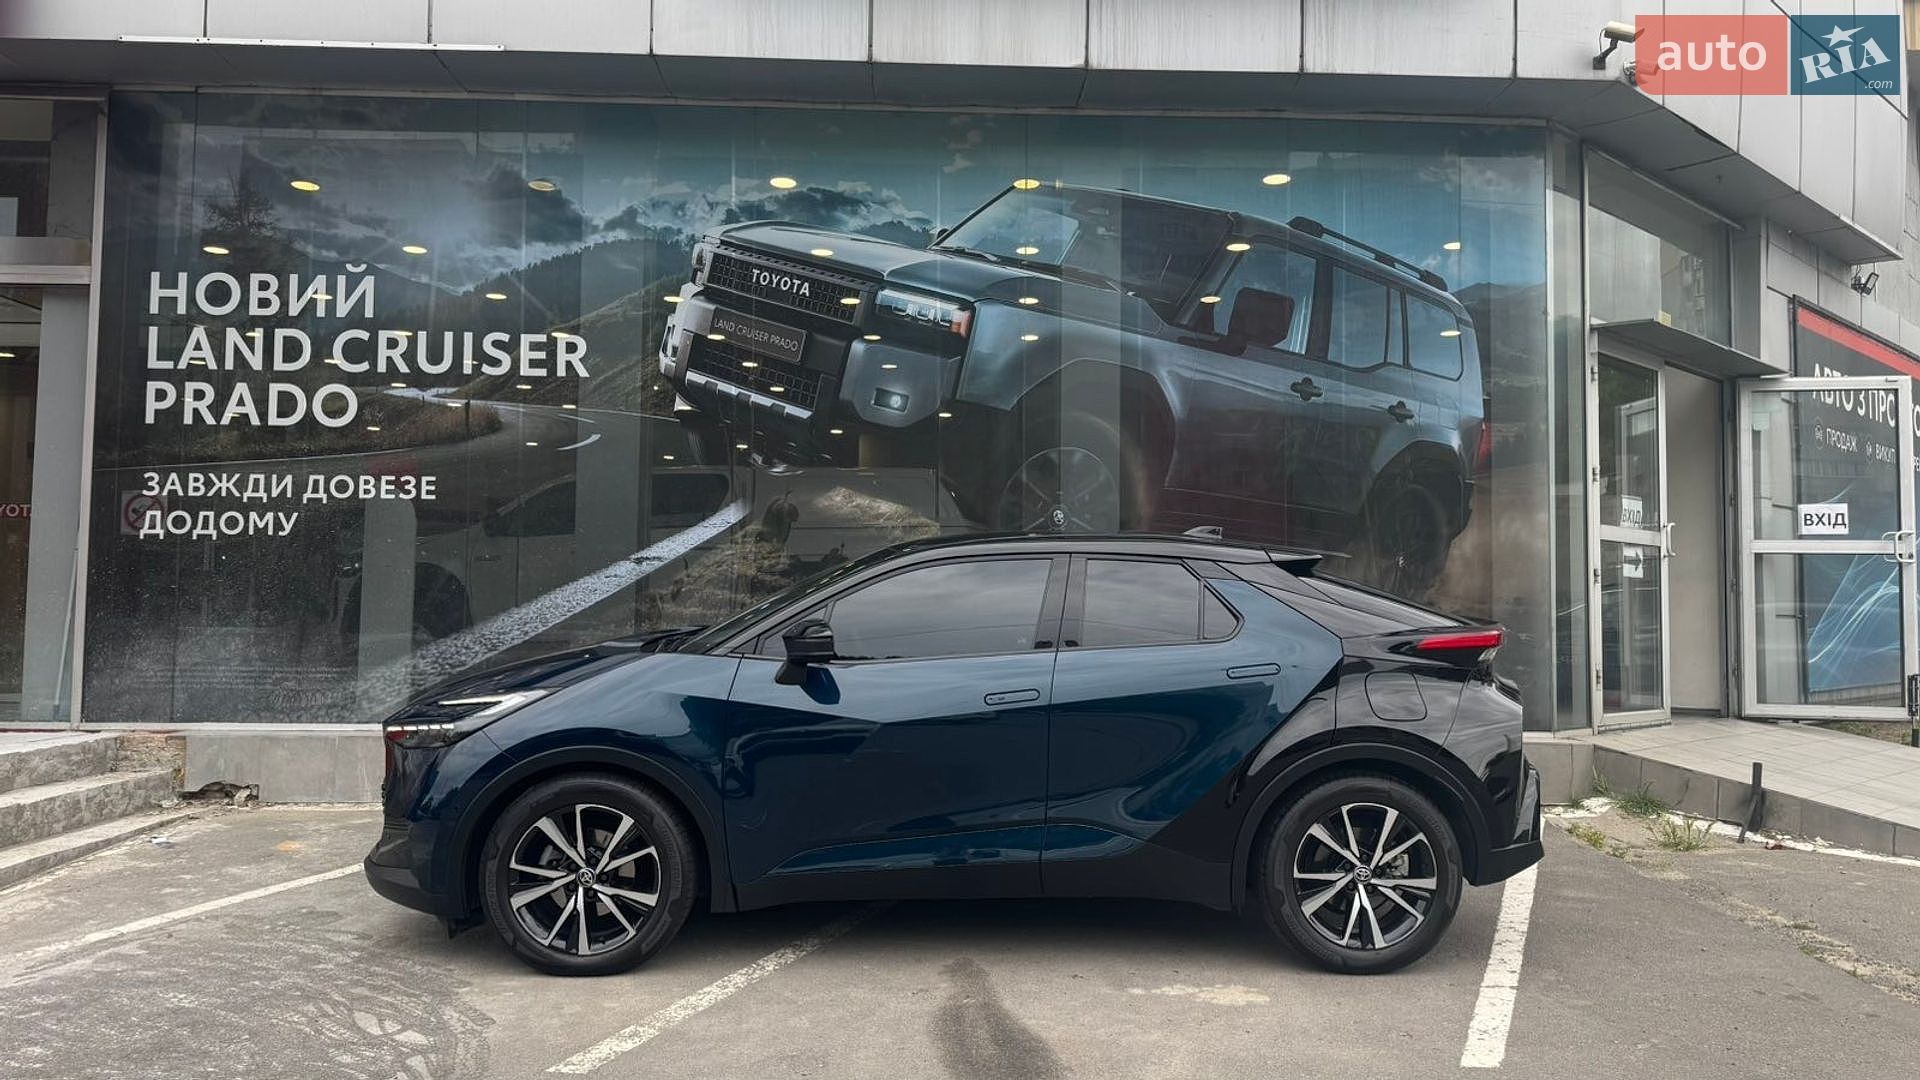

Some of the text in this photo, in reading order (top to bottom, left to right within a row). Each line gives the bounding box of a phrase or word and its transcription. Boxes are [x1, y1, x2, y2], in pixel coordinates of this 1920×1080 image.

[149, 263, 375, 318] НОВИЙ
[752, 268, 810, 297] TOYOTA
[714, 319, 799, 351] LAND CRUISER PRADO
[147, 326, 590, 378] LAND CRUISER
[145, 381, 358, 428] PRADO
[142, 472, 437, 503] ЗАВЖДИ ДОВЕЗЕ
[139, 510, 299, 540] ДОДОМУ
[1803, 513, 1847, 529] ВХІД
